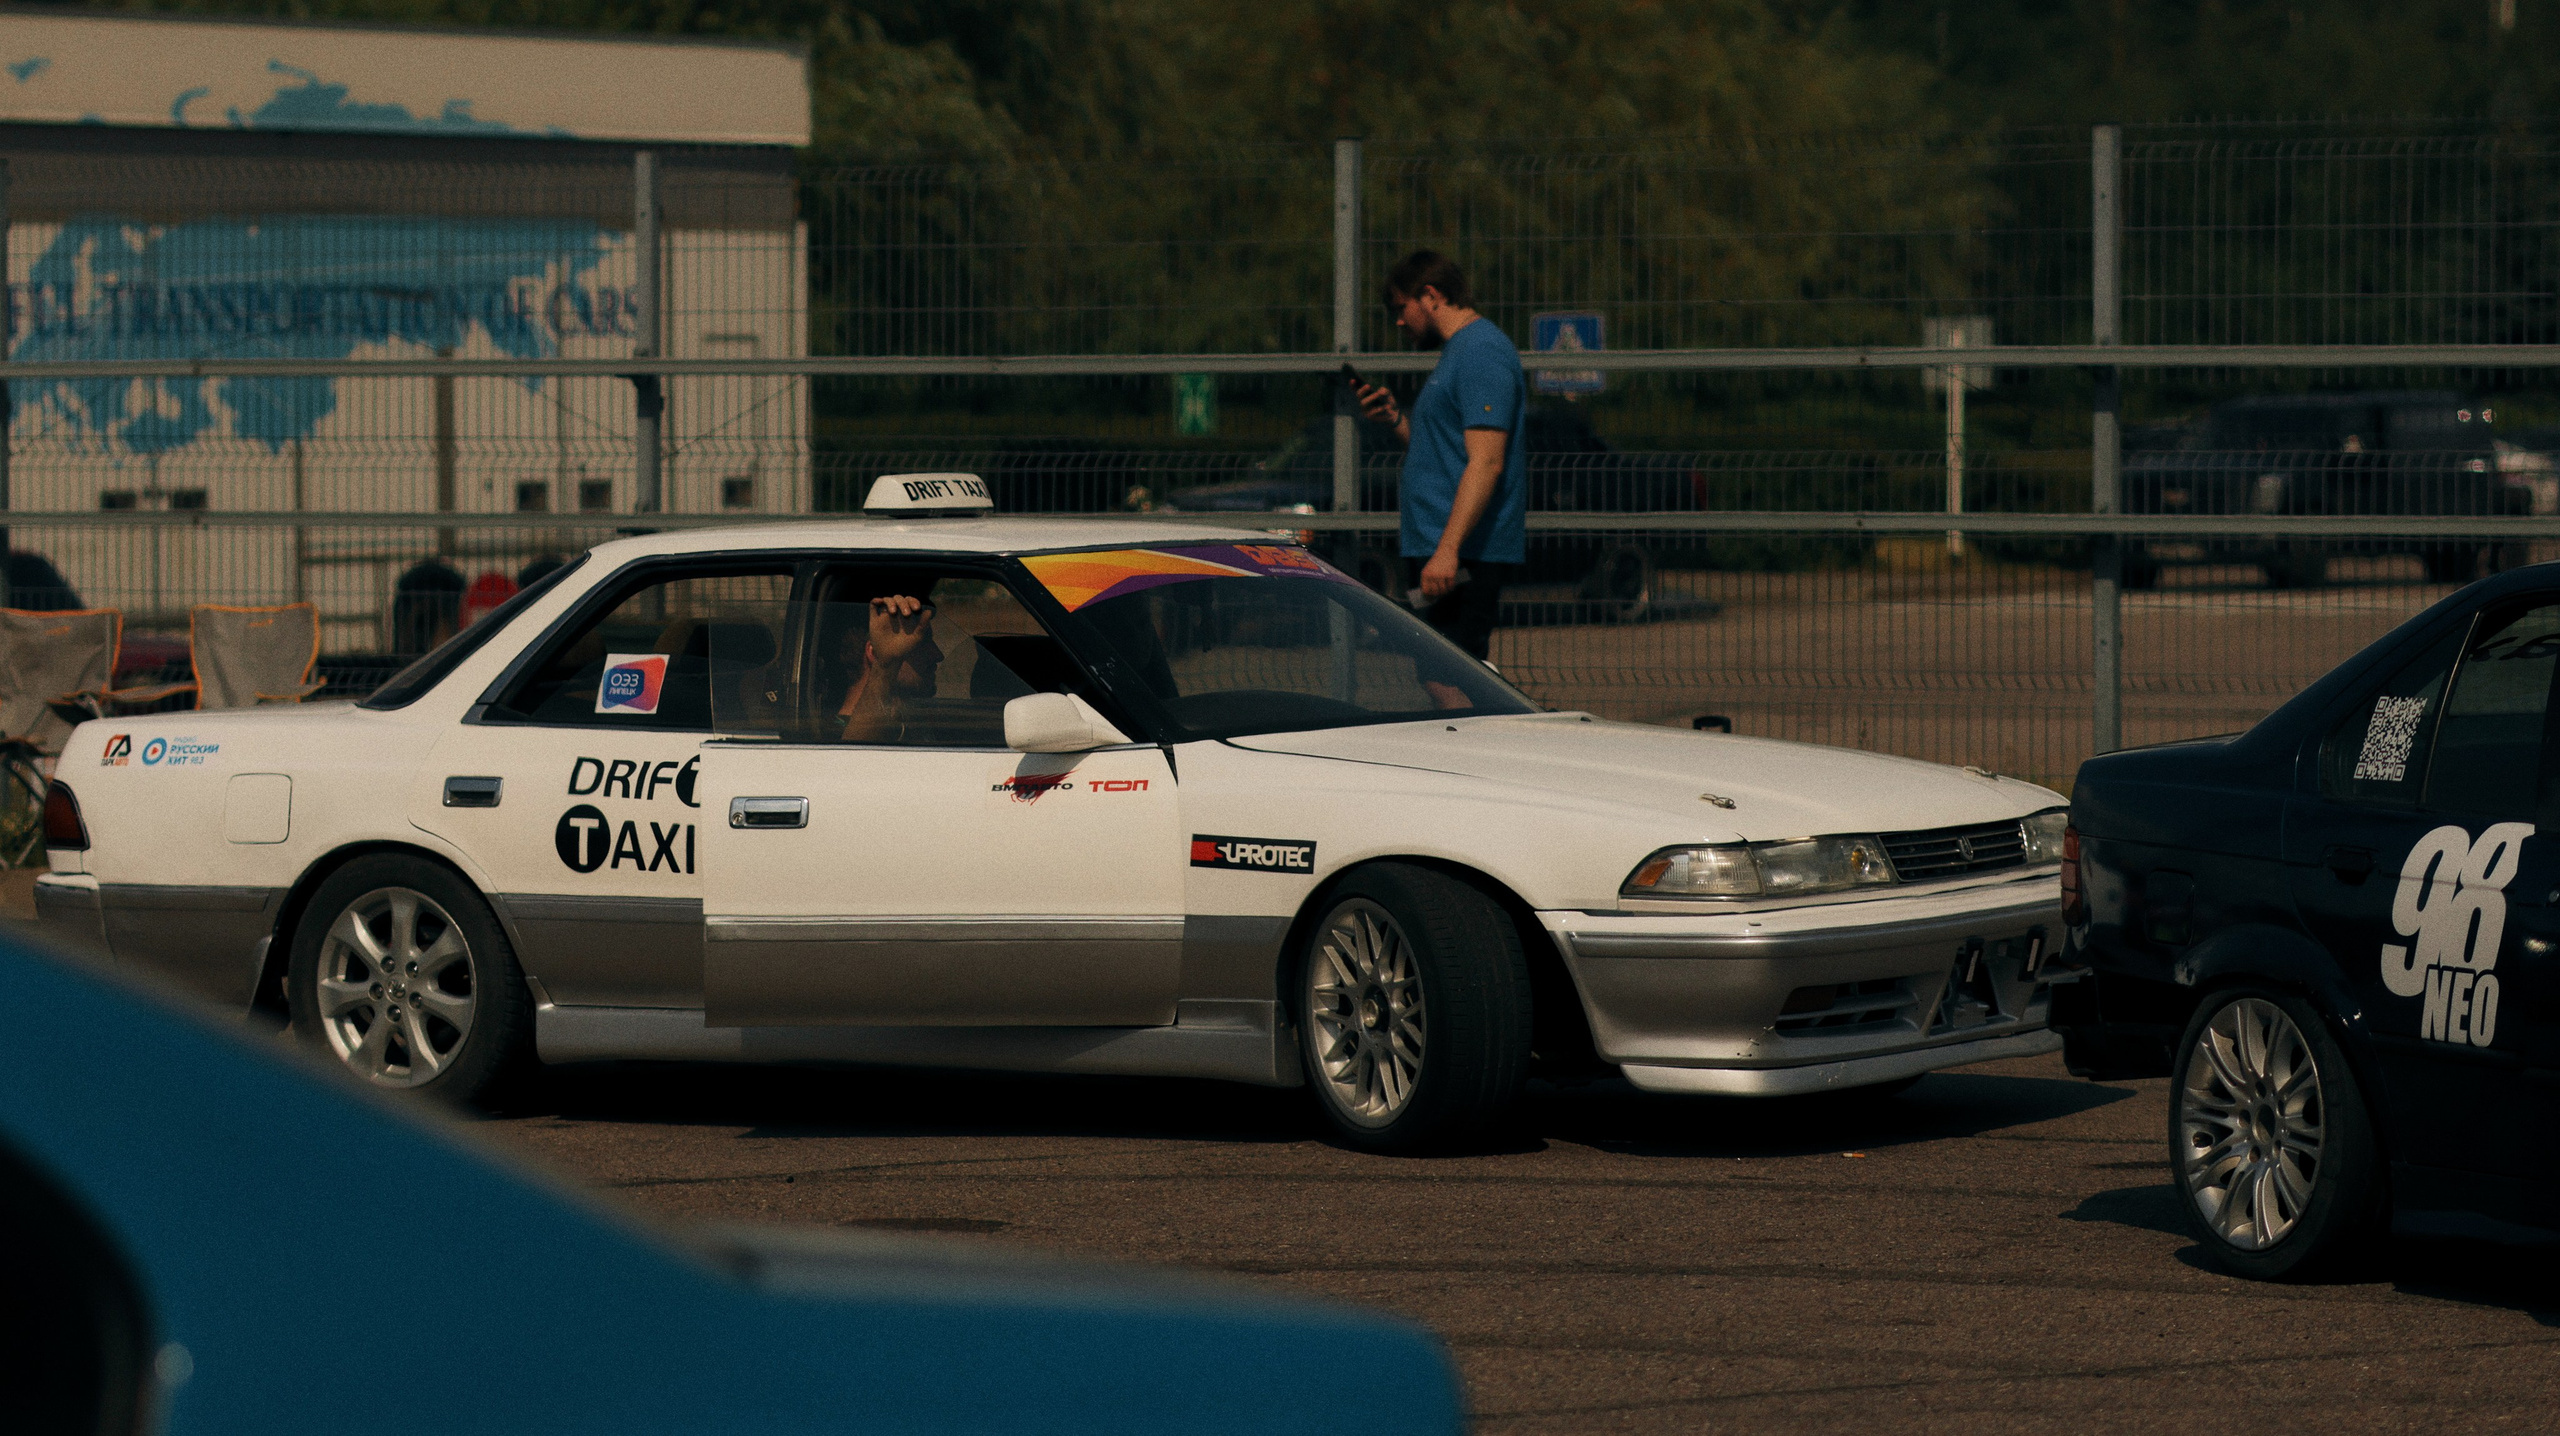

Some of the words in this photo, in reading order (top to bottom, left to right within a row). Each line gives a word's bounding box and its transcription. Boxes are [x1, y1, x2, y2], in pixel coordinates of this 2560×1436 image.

[104, 281, 474, 338] TRANSPORTATION
[903, 480, 954, 501] DRIFT
[610, 673, 639, 687] ОЭЗ
[609, 687, 637, 696] ЛИПЕЦК
[166, 755, 188, 766] ХИТ
[555, 804, 695, 874] TAXI
[2421, 968, 2500, 1048] NEO
